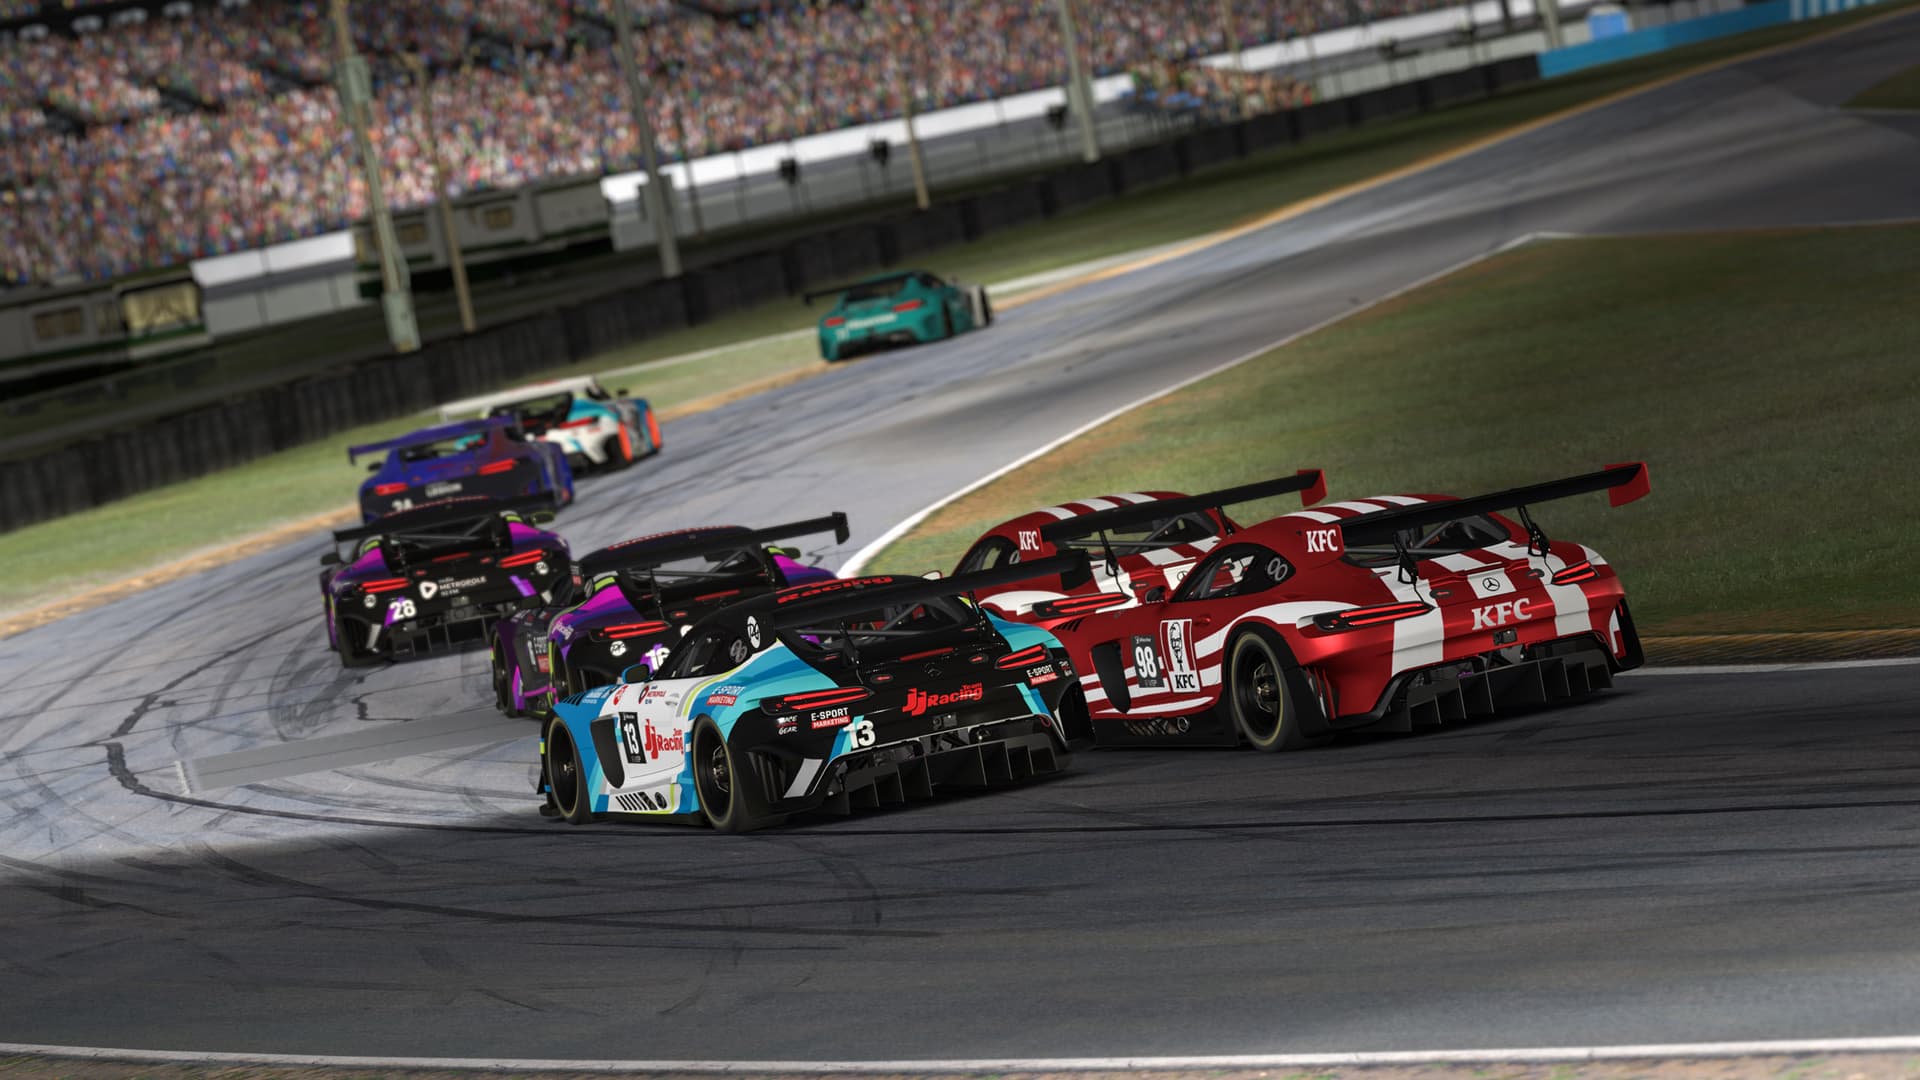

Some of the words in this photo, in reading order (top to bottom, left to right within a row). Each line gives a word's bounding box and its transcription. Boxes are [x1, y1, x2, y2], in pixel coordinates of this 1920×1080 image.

[1018, 530, 1039, 551] KFC
[1306, 529, 1338, 552] KFC
[439, 576, 486, 590] METROPOLE
[390, 600, 417, 620] 28
[1471, 598, 1532, 630] KFC
[1135, 646, 1157, 679] 98
[1026, 664, 1054, 678] E-SPORT
[1175, 674, 1195, 689] KFC
[711, 685, 746, 696] E-SPORT
[707, 695, 737, 706] MARKETING
[811, 707, 849, 721] E-SPORT
[812, 716, 850, 729] MARKETING
[778, 726, 798, 736] GEAR
[843, 719, 876, 749] 13
[624, 723, 639, 755] 13
